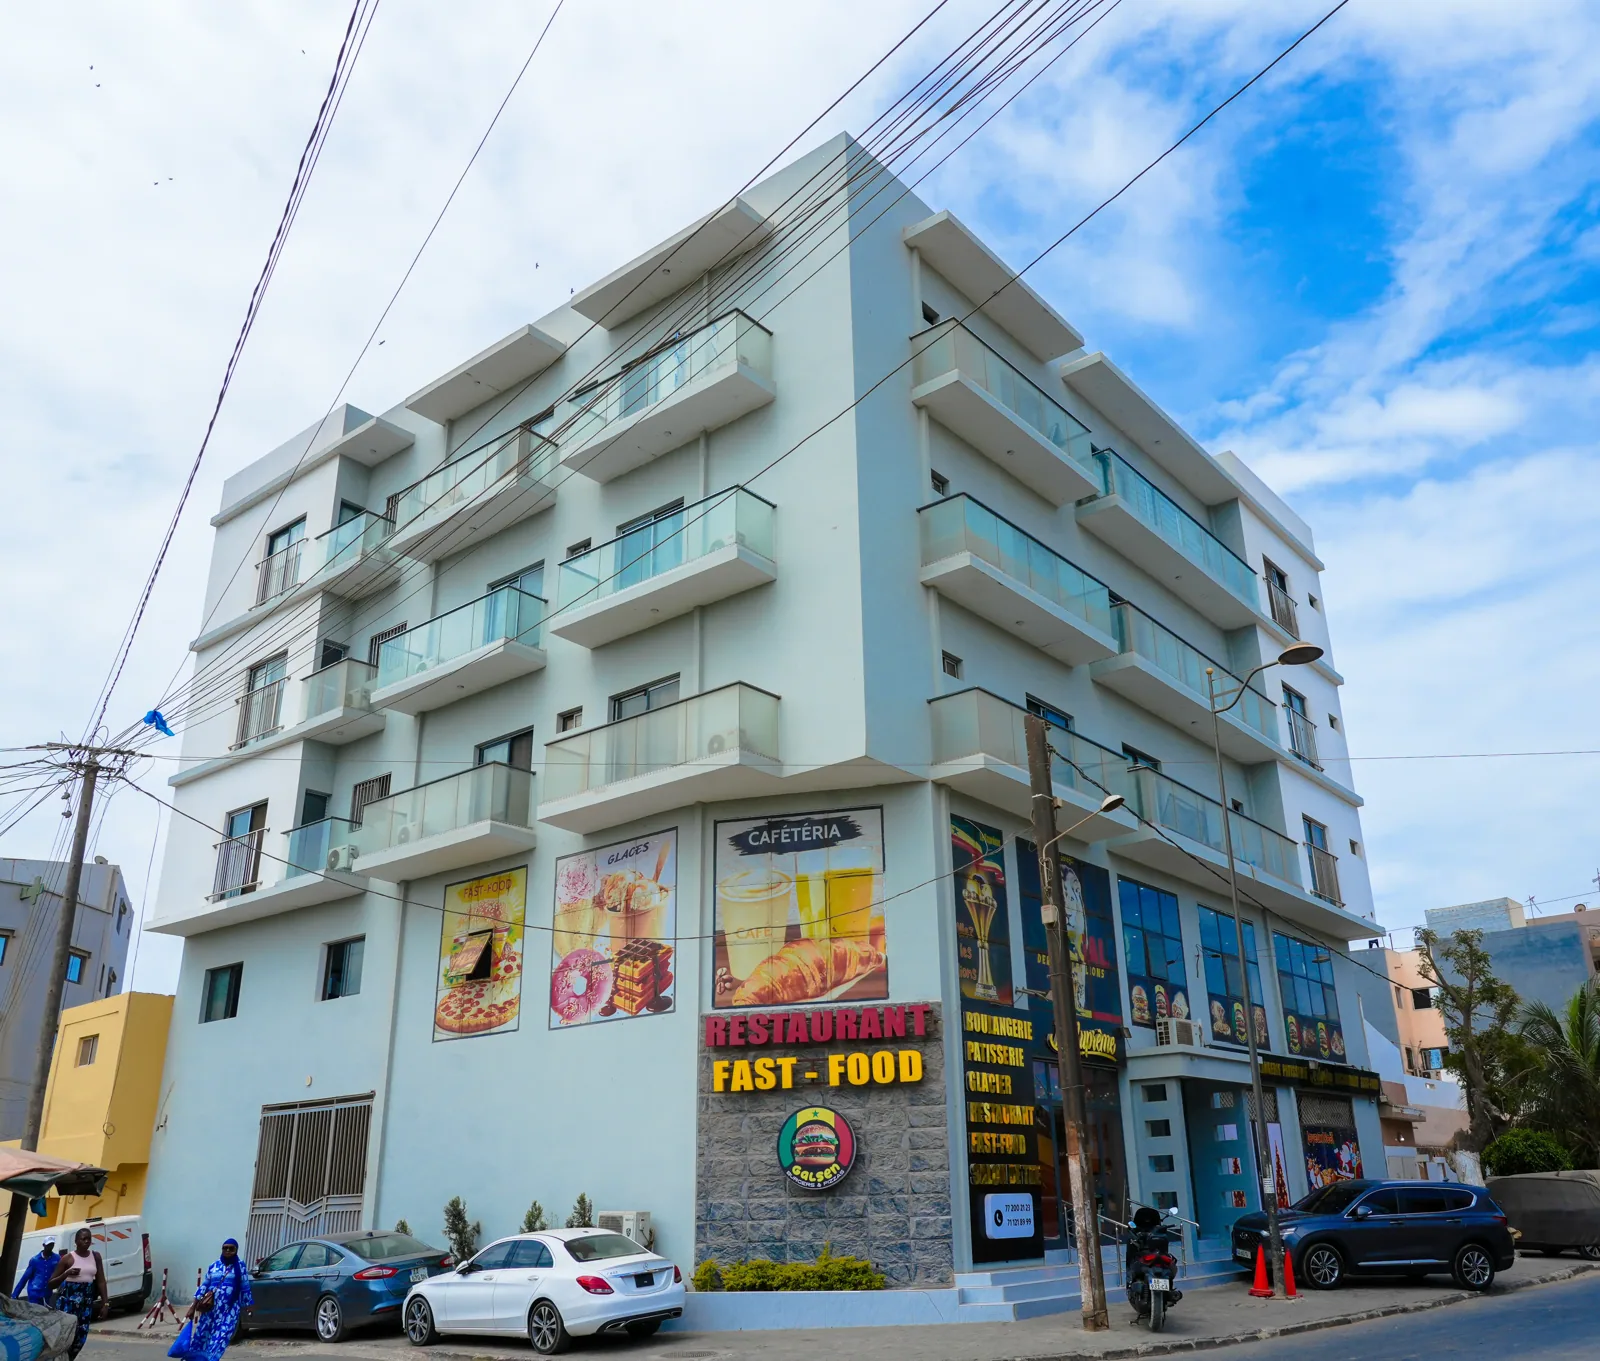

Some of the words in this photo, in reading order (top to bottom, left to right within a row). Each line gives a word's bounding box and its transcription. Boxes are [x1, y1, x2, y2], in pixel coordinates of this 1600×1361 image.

[748, 822, 841, 846] CAFÉTÉRIA
[607, 842, 650, 865] GLACES
[463, 878, 513, 899] FAST-FOOD
[959, 965, 978, 981] ions
[705, 1004, 930, 1047] RESTAURANT
[964, 1011, 1033, 1041] BOULANGERIE
[966, 1040, 1025, 1067] PATISSERIE
[713, 1057, 797, 1093] FAST
[828, 1050, 923, 1087] FOOD
[967, 1070, 1013, 1095] GLACIER
[968, 1101, 1035, 1126] RESTAURANT
[969, 1132, 1027, 1155] FAST-FOOD
[786, 1170, 816, 1188] BURGERS
[822, 1169, 845, 1187] PIZZAS
[1005, 1204, 1011, 1212] 77
[1011, 1204, 1020, 1212] 200
